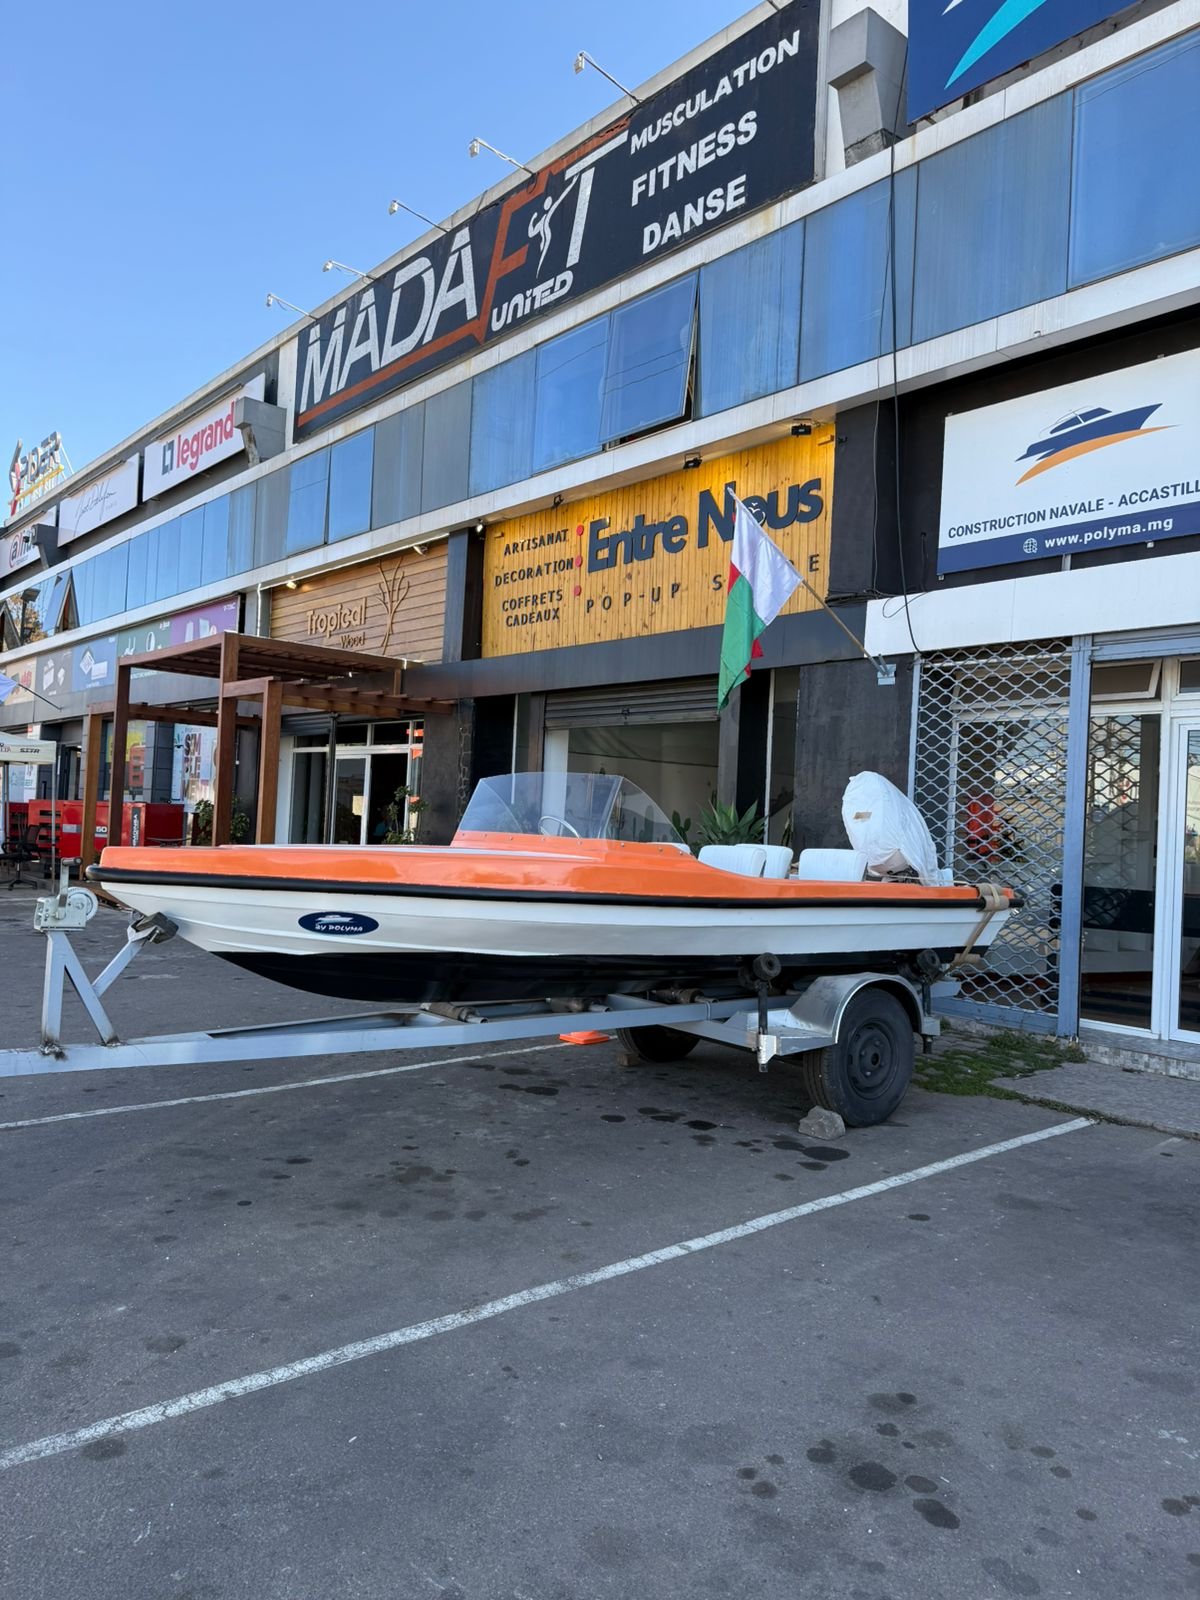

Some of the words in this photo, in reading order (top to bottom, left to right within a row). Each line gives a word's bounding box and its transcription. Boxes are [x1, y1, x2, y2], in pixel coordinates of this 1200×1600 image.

[630, 29, 800, 155] MUSCULATION
[631, 110, 758, 207] FITNESS
[642, 174, 747, 255] DANSE
[176, 400, 235, 471] legrand
[948, 509, 1047, 539] CONSTRUCTION
[1049, 498, 1105, 520] NAVALE
[1118, 480, 1200, 507] ACCASTILL
[504, 528, 569, 557] ARTISANAT
[588, 514, 688, 574] Entre
[1044, 518, 1174, 549] www.polyma.mg
[494, 558, 574, 587] DECORATION
[502, 589, 563, 612] COFFRETS
[586, 582, 681, 613] POP-UP
[306, 597, 368, 639] Tropical
[505, 609, 560, 628] CADEAUX
[340, 631, 366, 649] Wood
[328, 924, 363, 932] POLYMA
